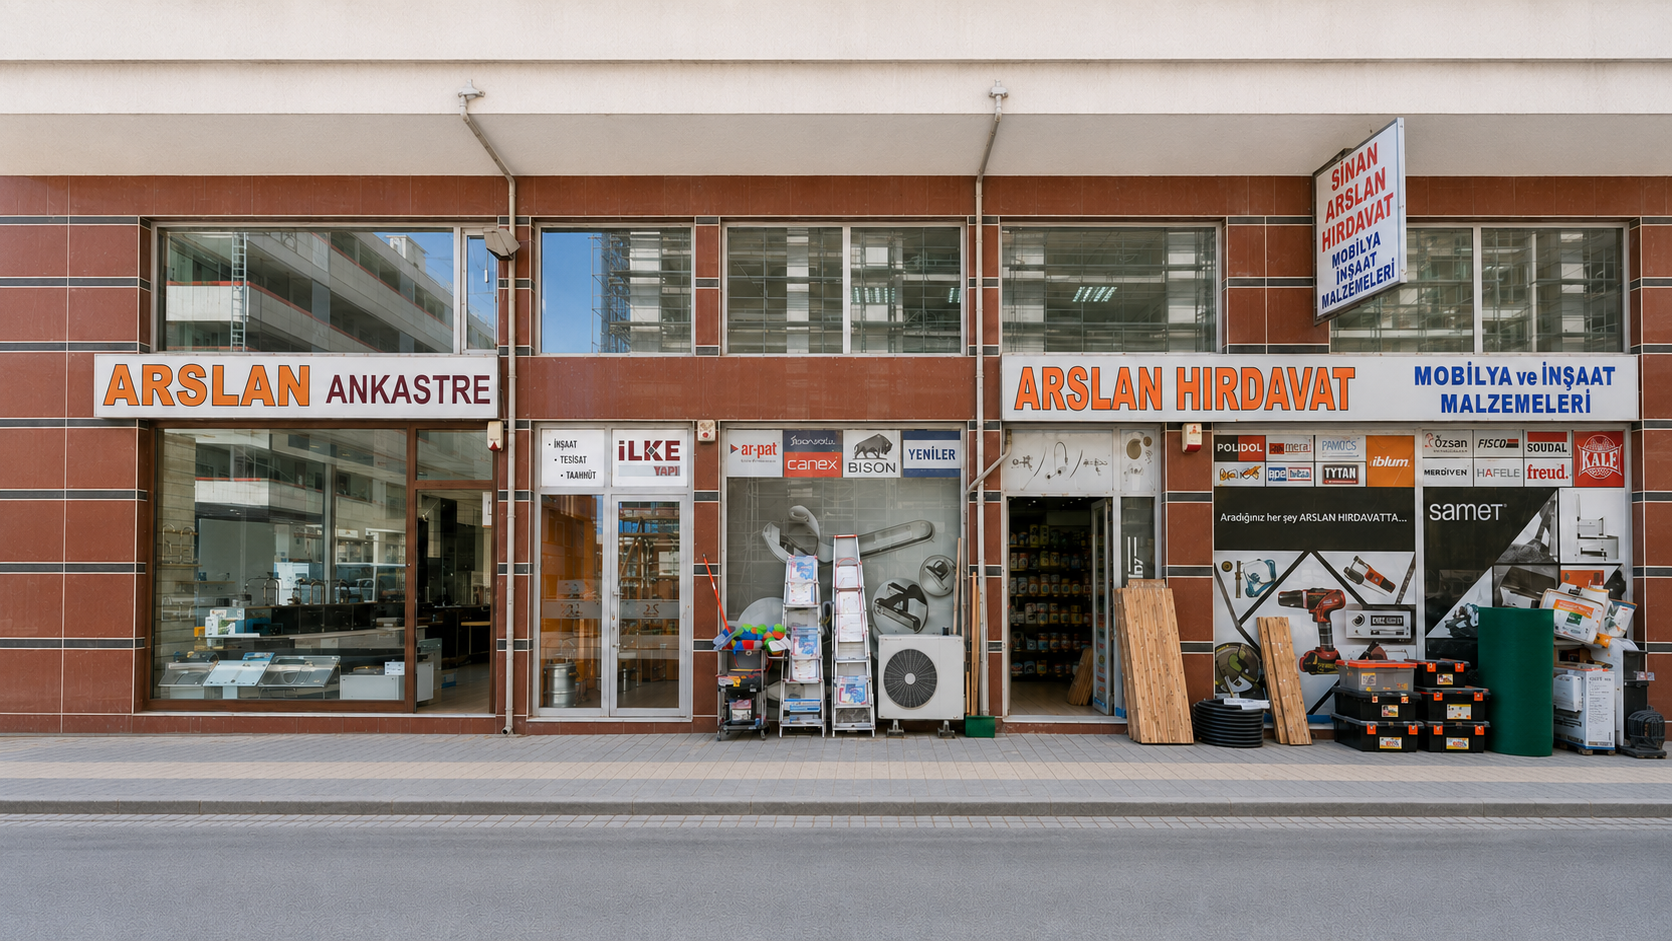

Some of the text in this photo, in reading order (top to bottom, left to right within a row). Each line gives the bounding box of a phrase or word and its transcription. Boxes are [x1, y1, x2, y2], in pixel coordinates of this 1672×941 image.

[1331, 142, 1378, 191] SİNAN
[1325, 167, 1386, 224] ARSLAN
[1322, 192, 1394, 253] HIRDAVAT
[1332, 231, 1381, 269] MOBİLYA
[1336, 252, 1377, 285] İNŞAAT
[1322, 257, 1395, 310] MALZEMELERİ
[103, 363, 491, 407] ARSLAN ANKASTRE
[1414, 361, 1616, 390] MOBİLYA ve İNŞAAT
[1014, 366, 1356, 412] ARSLAN HIRDAVAT
[1440, 388, 1592, 414] MALZEMELERİ
[908, 446, 956, 460] YENİLER
[1217, 443, 1262, 452] POLIDOL
[1478, 439, 1506, 448] FISCO
[1527, 443, 1567, 452] SOUDAL
[560, 455, 587, 464] TESİSAT
[787, 459, 838, 470] canex
[848, 462, 896, 473] BISON
[1582, 450, 1618, 471] KALE
[653, 466, 678, 476] YAPI
[1325, 468, 1356, 479] TYTAN
[1220, 513, 1264, 524] Aradığınız
[1267, 513, 1281, 522] her
[1283, 515, 1297, 524] şey
[1299, 513, 1336, 522] ARSLAN
